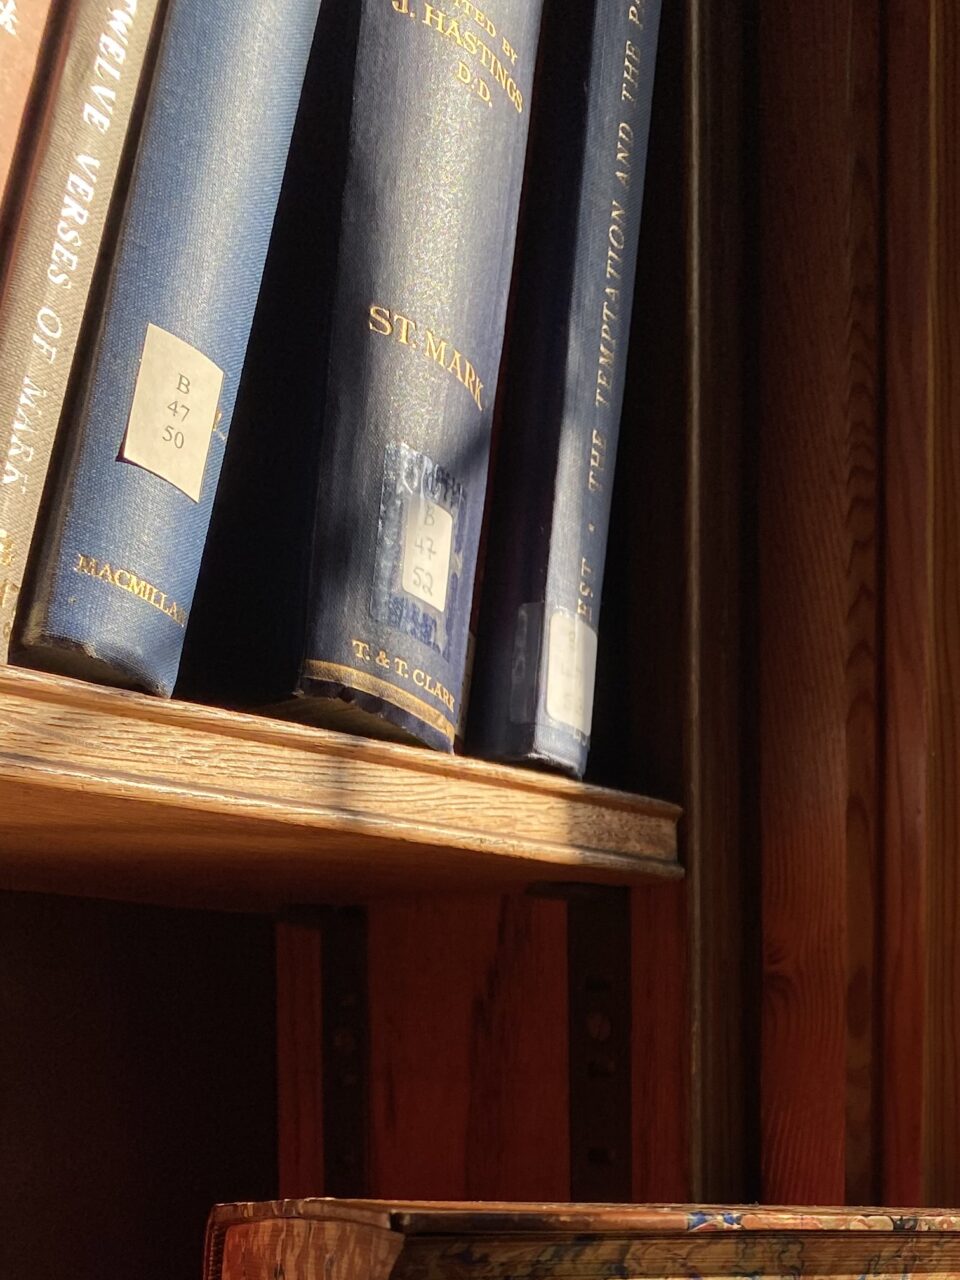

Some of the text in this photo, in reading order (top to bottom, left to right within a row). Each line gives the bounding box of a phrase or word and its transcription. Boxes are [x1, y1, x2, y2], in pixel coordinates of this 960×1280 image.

[628, 0, 645, 31] P
[421, 3, 524, 114] HASTINGS
[501, 37, 518, 66] BY
[621, 39, 642, 108] THE
[615, 122, 634, 190] AND
[47, 152, 101, 290] VERSES
[595, 200, 627, 408] TEMPTATION
[32, 306, 62, 364] OF
[368, 304, 485, 412] ST. MARK
[166, 399, 191, 423] 47
[175, 372, 192, 395] B
[2, 375, 48, 495] MARK
[161, 425, 186, 449] 50
[587, 428, 608, 493] THE
[423, 503, 436, 527] B
[413, 536, 437, 561] 47
[412, 565, 434, 597] 52
[351, 639, 456, 714] T. & T. CLARK
